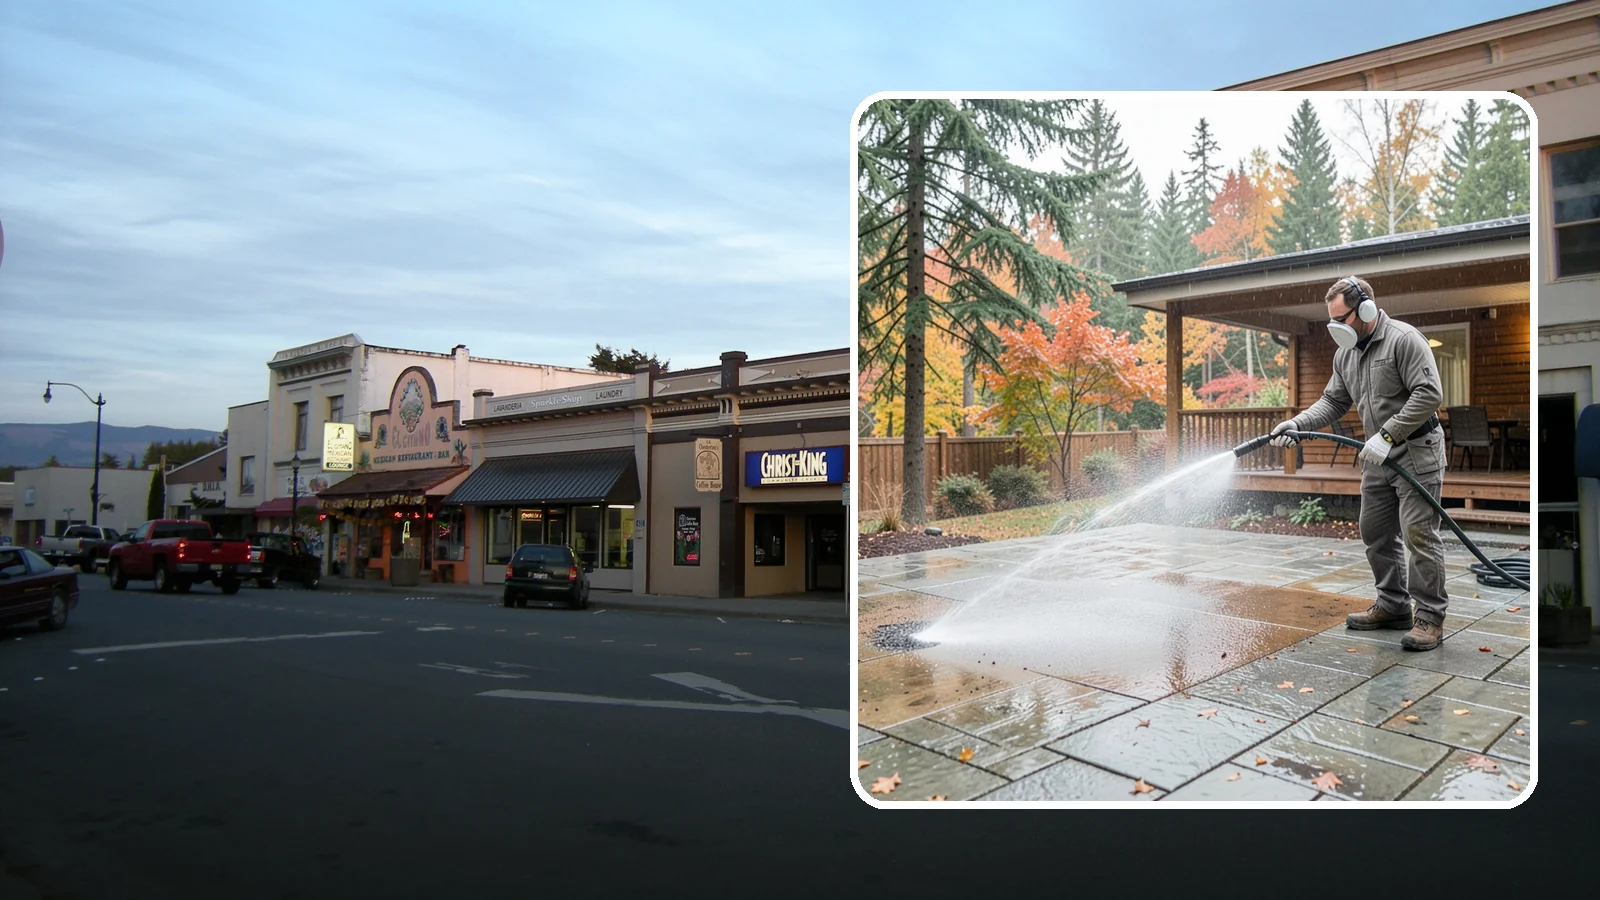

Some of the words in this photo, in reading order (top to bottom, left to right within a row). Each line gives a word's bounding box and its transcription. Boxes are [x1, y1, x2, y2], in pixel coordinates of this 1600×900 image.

[561, 394, 583, 406] Shop
[595, 388, 623, 401] LAUNDRY
[493, 402, 523, 413] LAVANDERIA
[373, 454, 397, 465] MEXICAN
[397, 451, 434, 463] RESTAURANT
[437, 449, 451, 460] BAR
[798, 449, 828, 476] KING
